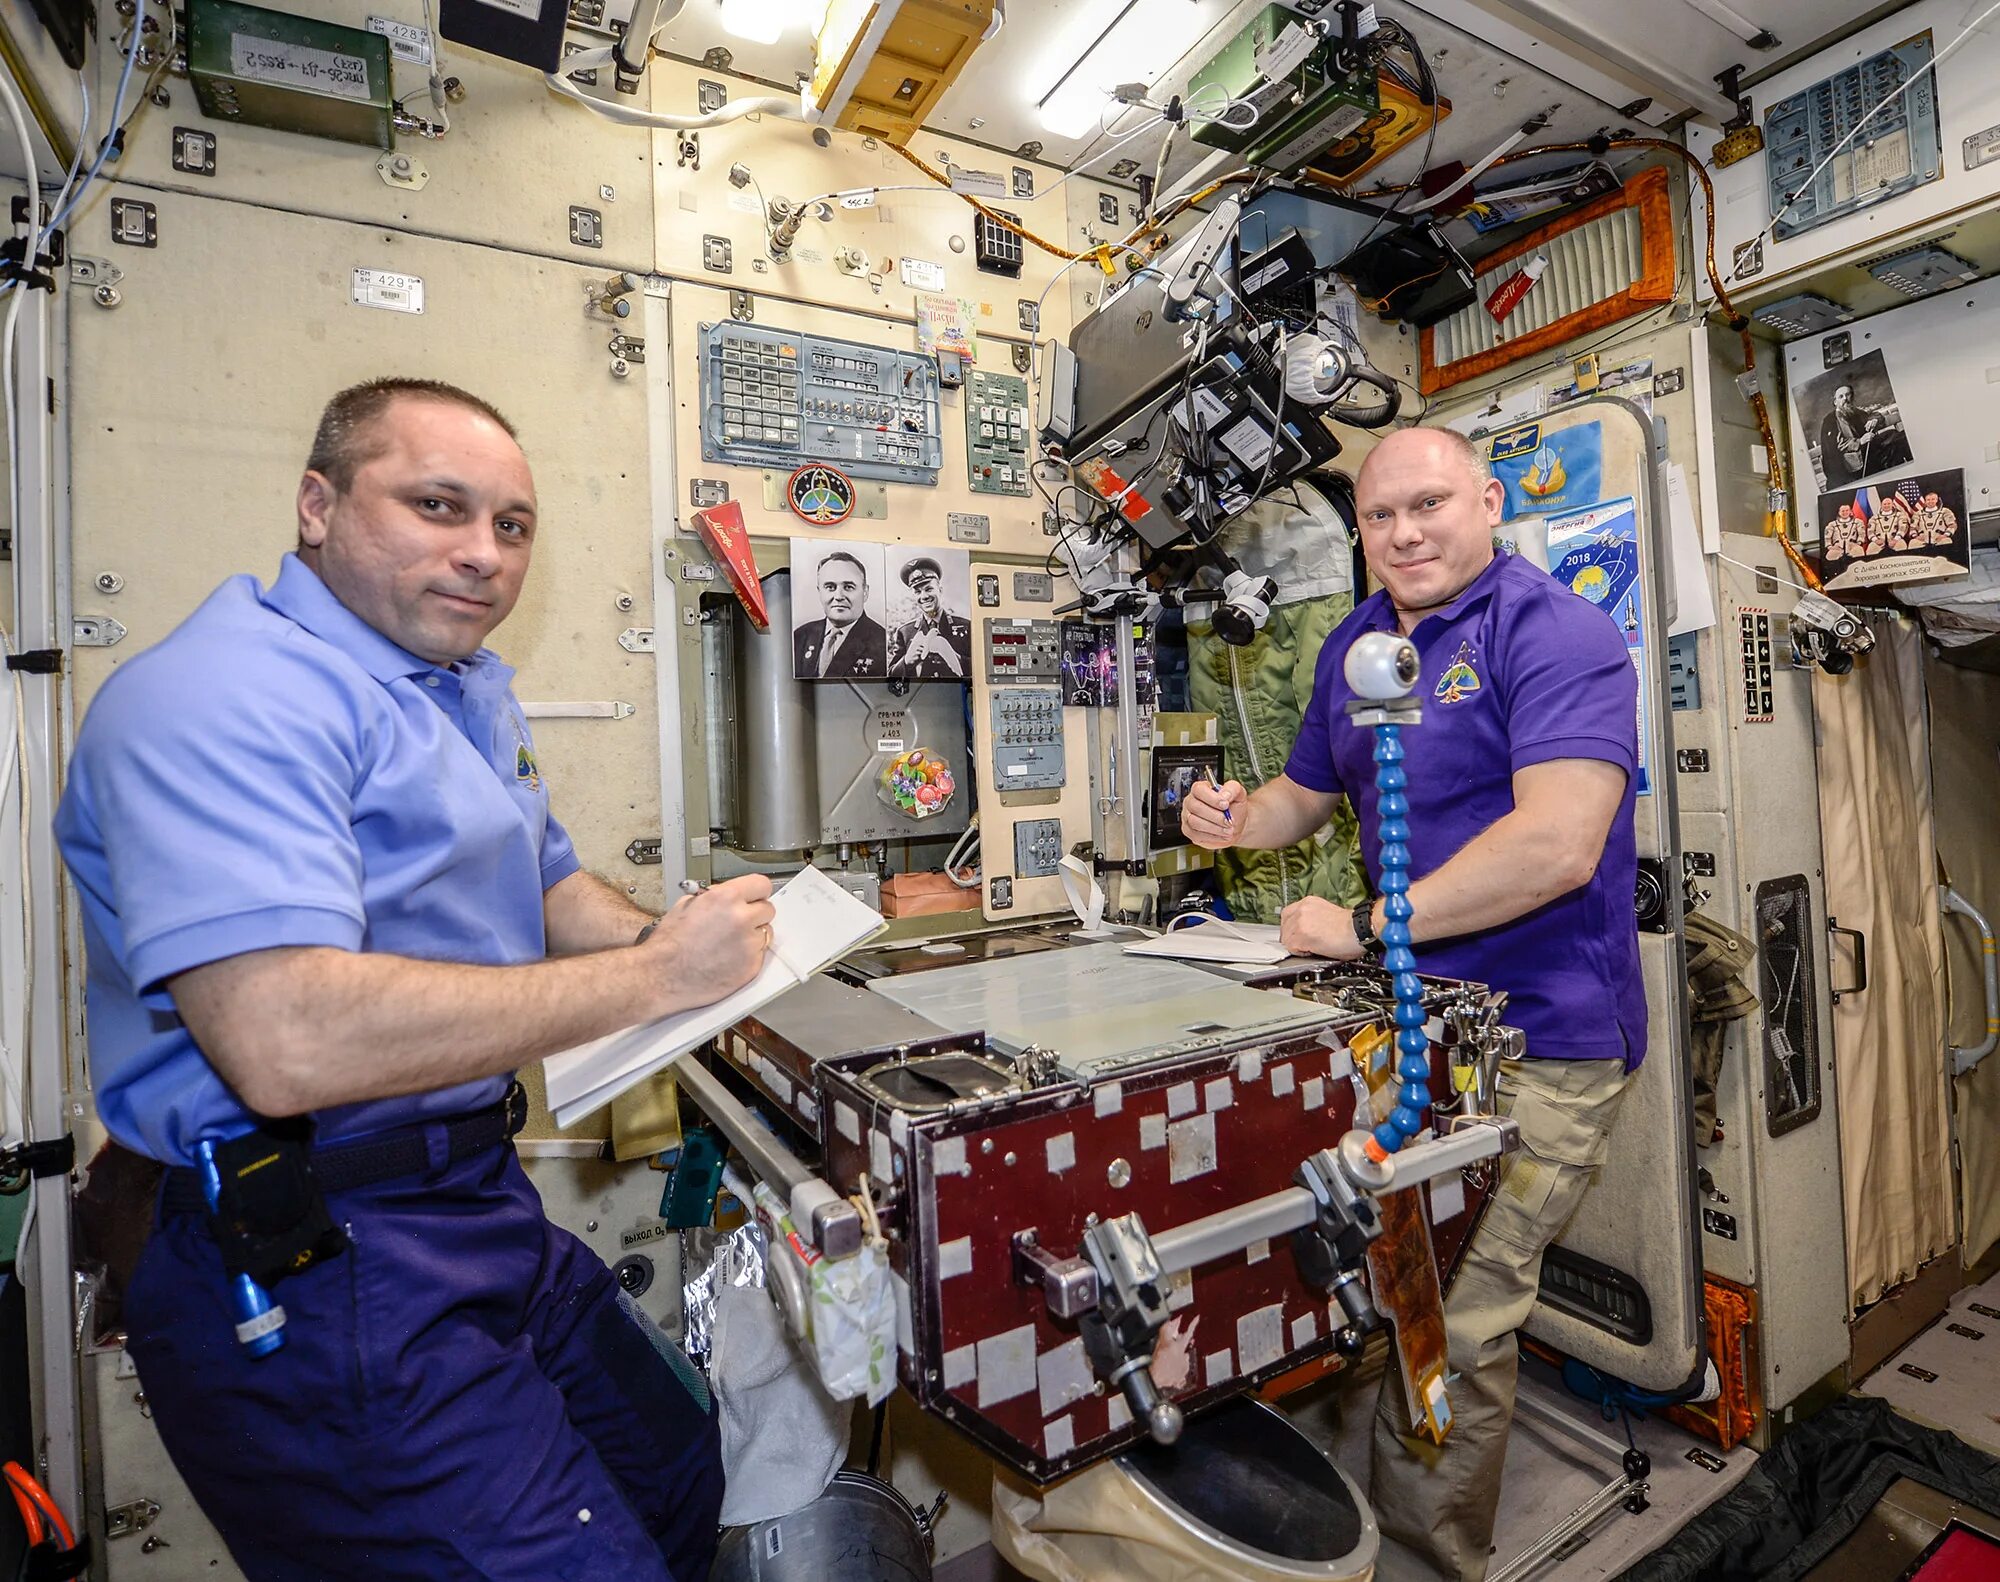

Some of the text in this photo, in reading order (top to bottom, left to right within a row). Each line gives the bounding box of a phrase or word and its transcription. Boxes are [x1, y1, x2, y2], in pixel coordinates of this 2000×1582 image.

[393, 25, 417, 40] 428
[379, 275, 404, 288] 429
[1521, 495, 1567, 507] БАЙКОНУР
[963, 517, 979, 526] 432
[706, 514, 733, 549] Москва
[1566, 552, 1590, 566] 2018
[624, 1229, 653, 1245] ВЫХОД
